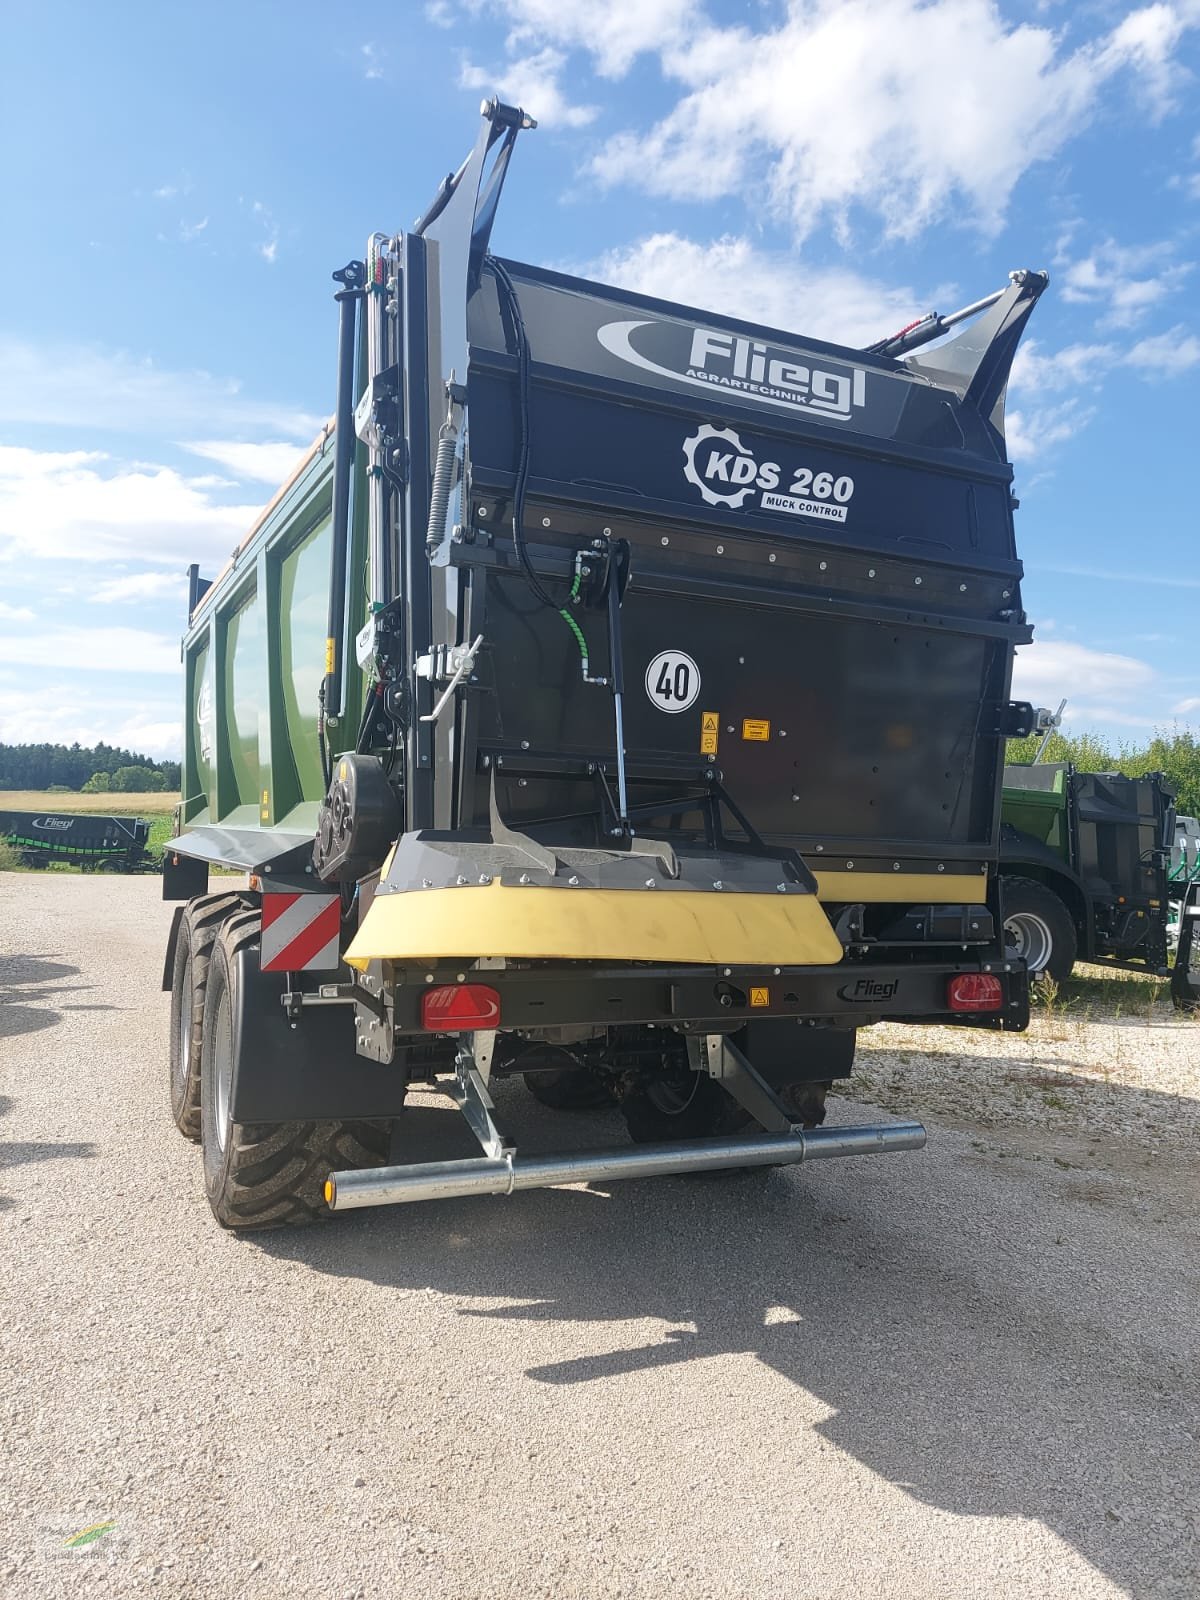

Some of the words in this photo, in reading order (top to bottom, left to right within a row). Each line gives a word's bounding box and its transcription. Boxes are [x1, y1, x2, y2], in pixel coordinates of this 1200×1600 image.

[686, 369, 808, 405] AGRARTECHNIK
[689, 328, 866, 413] Fliegl
[704, 450, 782, 490] KDS
[789, 468, 854, 502] 260
[766, 496, 795, 510] MUCK
[798, 502, 844, 518] CONTROL
[655, 662, 690, 702] 40
[44, 817, 74, 830] Fliegl
[854, 979, 899, 999] Fliegl
